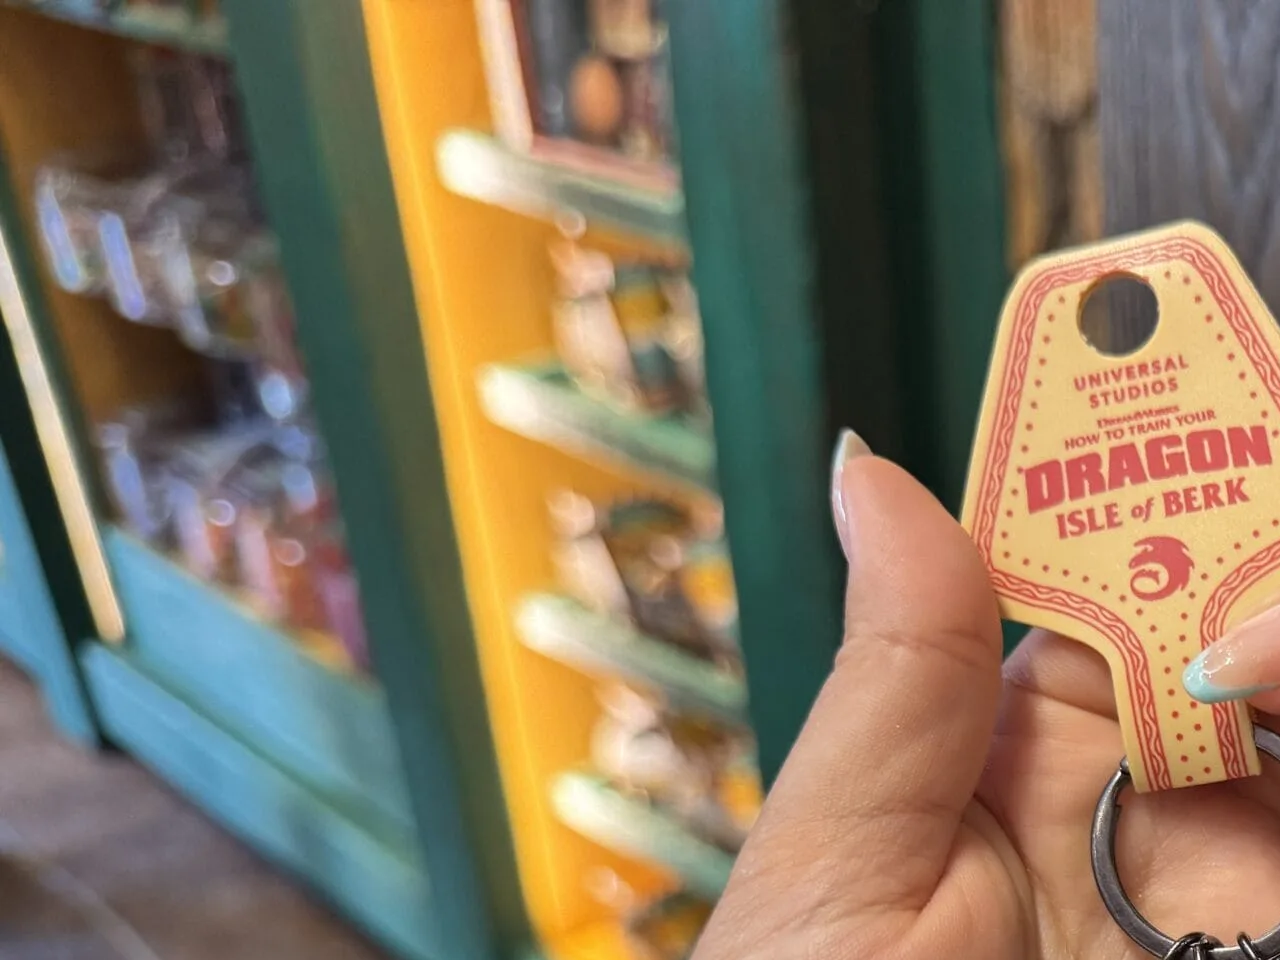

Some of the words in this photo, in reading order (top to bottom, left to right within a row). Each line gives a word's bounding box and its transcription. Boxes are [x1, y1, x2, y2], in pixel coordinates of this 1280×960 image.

[1073, 354, 1189, 392] UNIVERSAL
[1089, 377, 1179, 409] STUDIOS
[1064, 431, 1100, 451] HOW
[1105, 427, 1125, 441] TO
[1128, 418, 1171, 437] TRAIN
[1175, 409, 1217, 427] YOUR
[1023, 425, 1273, 515] DRAGON
[1055, 502, 1123, 540] ISLE
[1131, 498, 1155, 523] of
[1163, 476, 1251, 518] BERK
